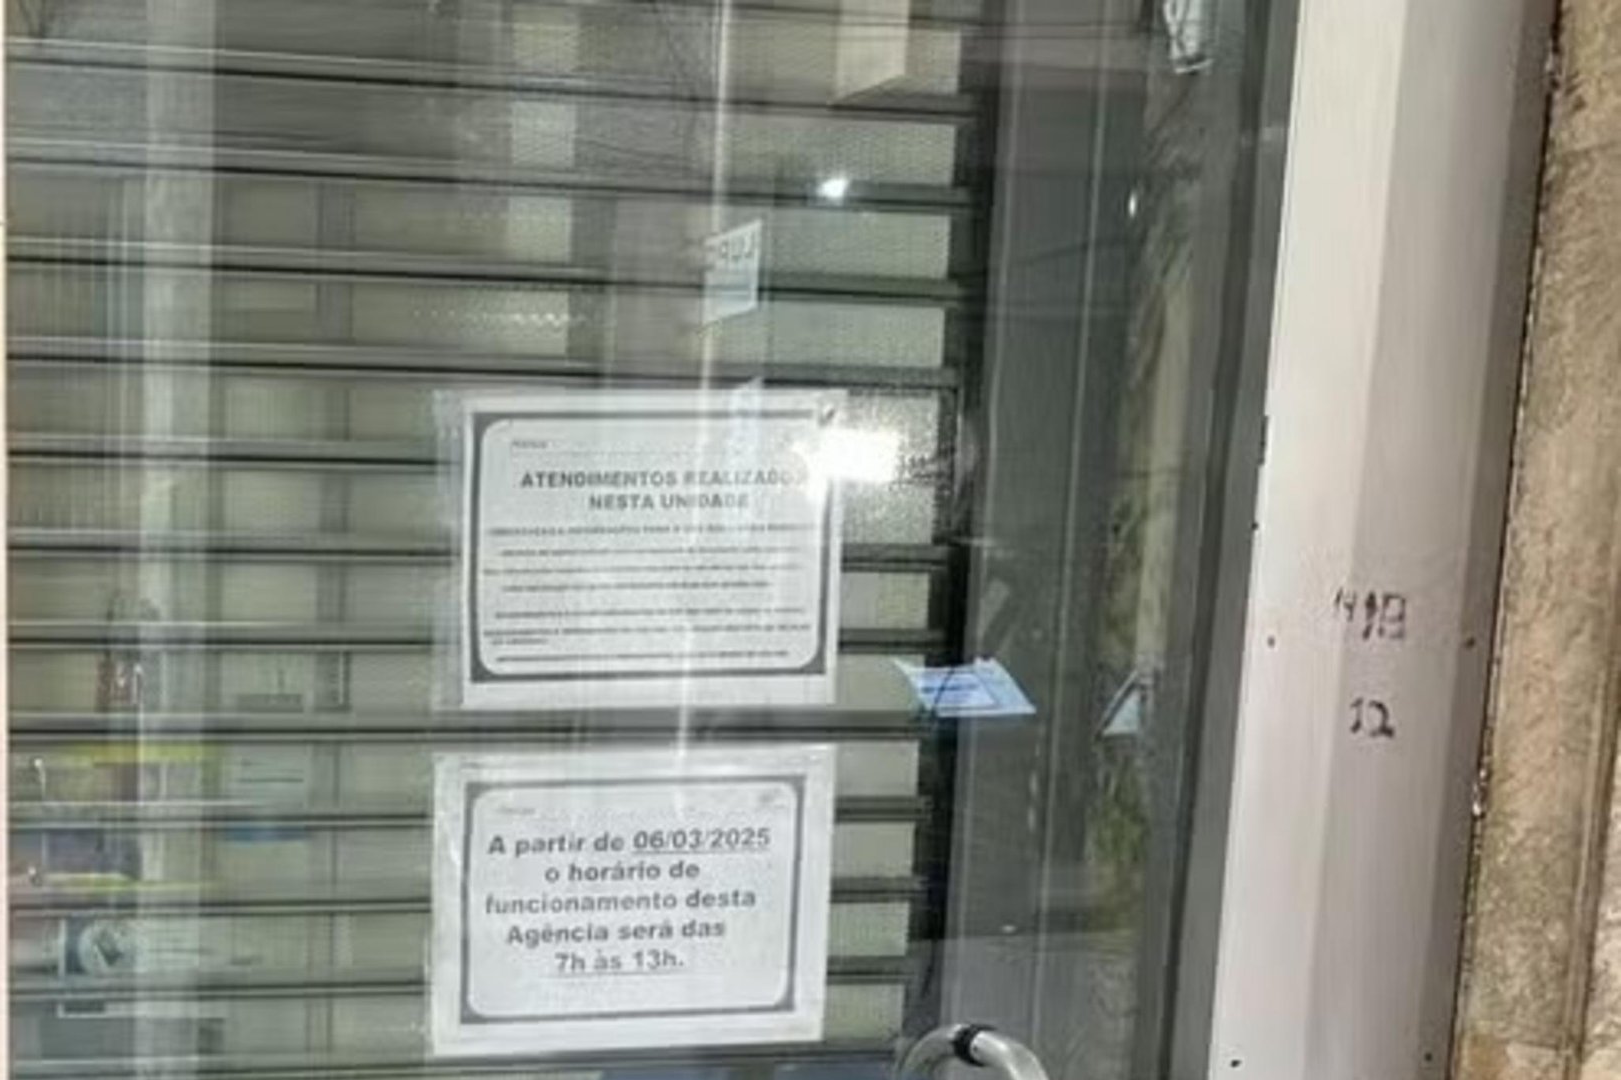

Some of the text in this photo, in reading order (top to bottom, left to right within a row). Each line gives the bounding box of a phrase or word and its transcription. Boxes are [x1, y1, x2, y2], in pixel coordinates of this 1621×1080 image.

[520, 469, 677, 488] ATENDIMENTOS
[589, 493, 654, 510] NESTA
[487, 827, 771, 858] A partir de 06/03/2025
[545, 860, 701, 883] o horário de
[485, 889, 757, 915] funcionamento desta
[507, 919, 726, 948] Agência será das
[555, 947, 685, 973] 7h às 13h.
